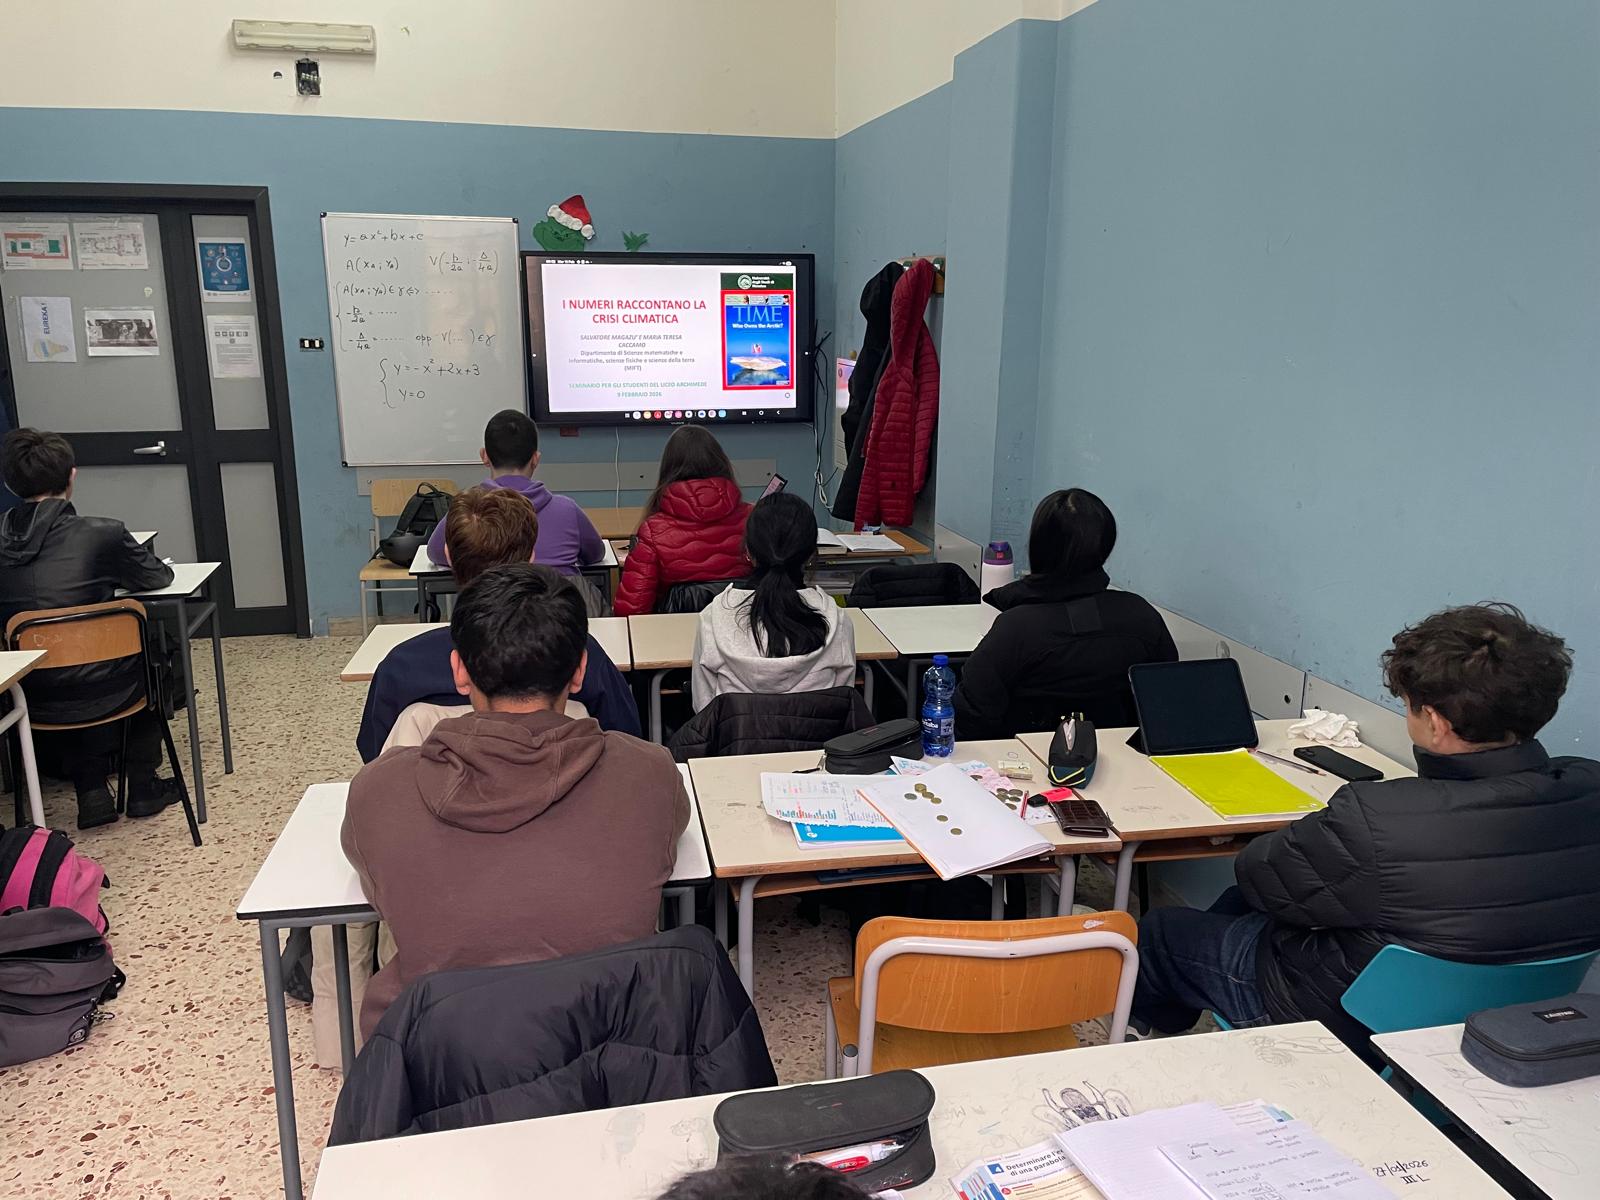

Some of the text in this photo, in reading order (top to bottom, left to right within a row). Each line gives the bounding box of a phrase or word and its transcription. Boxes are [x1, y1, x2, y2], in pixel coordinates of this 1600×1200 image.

[569, 299, 614, 310] NUMERI
[617, 299, 691, 310] RACCONTANO
[694, 300, 707, 310] LA
[592, 313, 679, 324] CRISI CLIMATICA
[732, 306, 783, 322] TIME
[1006, 1152, 1052, 1171] Determinare
[1020, 1167, 1033, 1175] una
[1034, 1154, 1066, 1173] parabola
